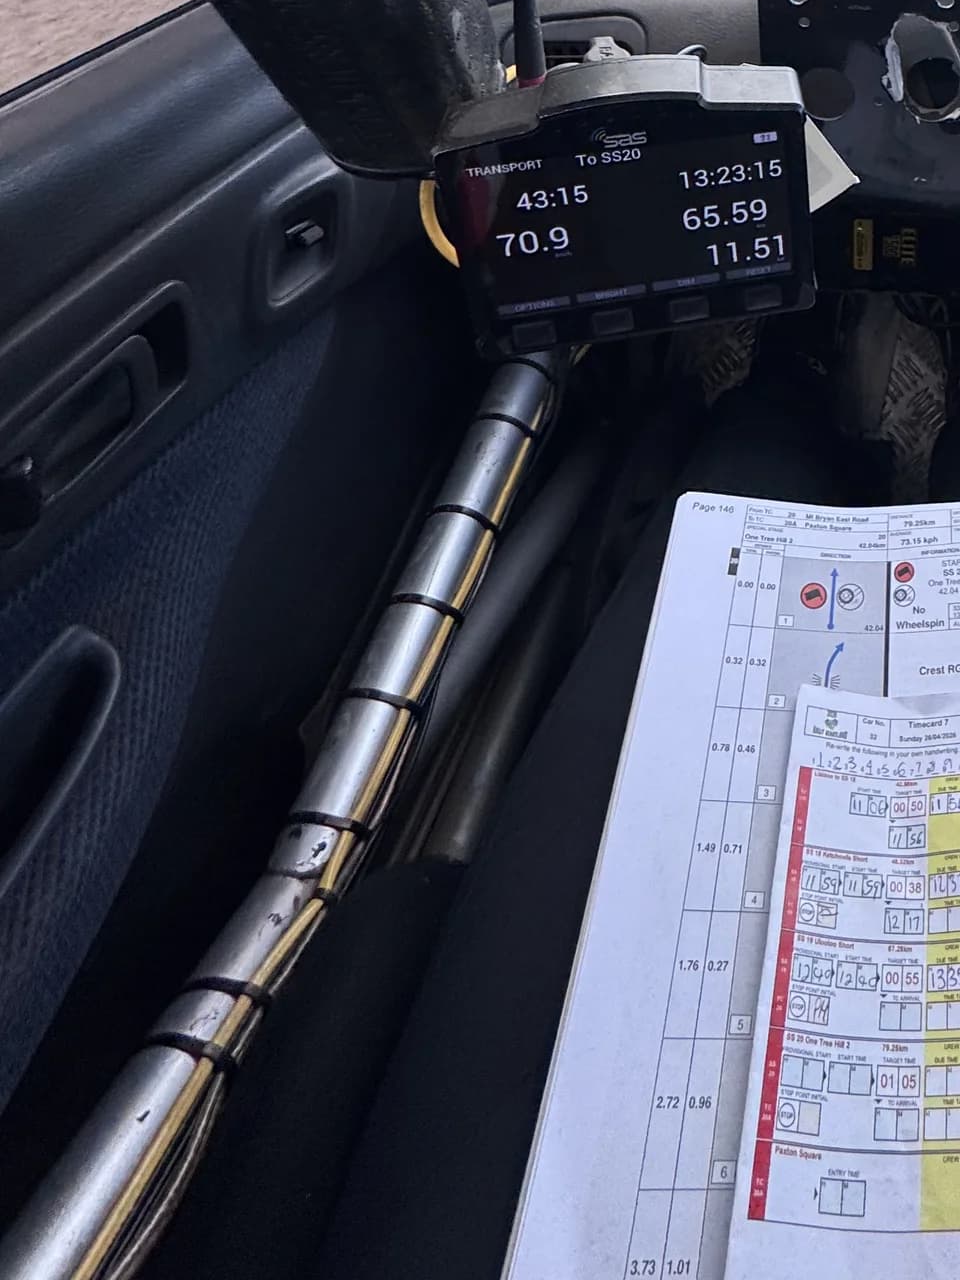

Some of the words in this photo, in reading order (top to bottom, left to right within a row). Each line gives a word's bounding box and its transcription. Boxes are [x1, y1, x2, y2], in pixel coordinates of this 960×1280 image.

[576, 152, 597, 167] To
[600, 148, 642, 164] SS20
[465, 158, 543, 177] TRANSPORT
[679, 159, 783, 189] 13:23:15
[516, 185, 589, 211] 43:15
[682, 199, 768, 231] 65.59
[496, 226, 570, 257] 70.9
[706, 234, 785, 266] 11.51
[692, 501, 716, 513] Page
[719, 504, 735, 514] 146
[744, 533, 759, 541] One
[760, 534, 775, 542] Tree
[900, 538, 922, 547] 73.15
[923, 536, 938, 546] kph
[943, 568, 955, 577] SS
[737, 580, 754, 589] 0.00
[759, 582, 776, 591] 0.00
[928, 578, 944, 588] One
[938, 587, 959, 595] 42.04
[912, 605, 926, 615] No
[864, 624, 884, 633] 42.04
[895, 618, 945, 630] Wheelspin
[725, 655, 744, 666] 0.32
[748, 657, 767, 668] 0.32
[919, 664, 945, 676] Crest
[774, 697, 780, 706] 2
[862, 717, 873, 725] Car
[909, 718, 943, 729] Timecard
[711, 742, 731, 754] 0.78
[736, 743, 756, 754] 0.46
[832, 756, 842, 770] 2
[848, 756, 857, 770] 3
[881, 765, 890, 774] 5
[763, 789, 769, 798] 3
[893, 801, 905, 813] 00
[910, 799, 923, 812] 50
[909, 830, 923, 845] 56
[696, 842, 716, 855] 1.49
[723, 842, 743, 855] 0.71
[890, 881, 903, 894] 00
[908, 881, 922, 894] 38
[751, 894, 758, 905] 4
[887, 915, 899, 929] 12
[908, 916, 920, 932] 17
[838, 941, 854, 950] Short
[678, 959, 700, 972] 1.76
[706, 960, 729, 972] 0.27
[885, 971, 898, 985] 00
[905, 971, 919, 985] 55
[737, 1019, 744, 1031] 5
[786, 1033, 796, 1042] SS
[805, 1036, 817, 1045] One
[819, 1038, 833, 1048] Tree
[834, 1039, 844, 1049] Hill
[845, 1040, 850, 1049] 2
[880, 1073, 894, 1088] 01
[901, 1074, 916, 1089] 05
[656, 1096, 680, 1110] 2.72
[688, 1096, 712, 1110] 0.96
[895, 1099, 917, 1107] ARRIVAL
[780, 1111, 794, 1121] STOP
[774, 1146, 798, 1157] Paxton
[799, 1149, 822, 1161] Square
[720, 1166, 728, 1178] 6
[827, 1169, 846, 1178] ENTRY
[847, 1169, 860, 1178] TIME
[630, 1260, 656, 1275] 3.73
[667, 1260, 691, 1275] 1.01
